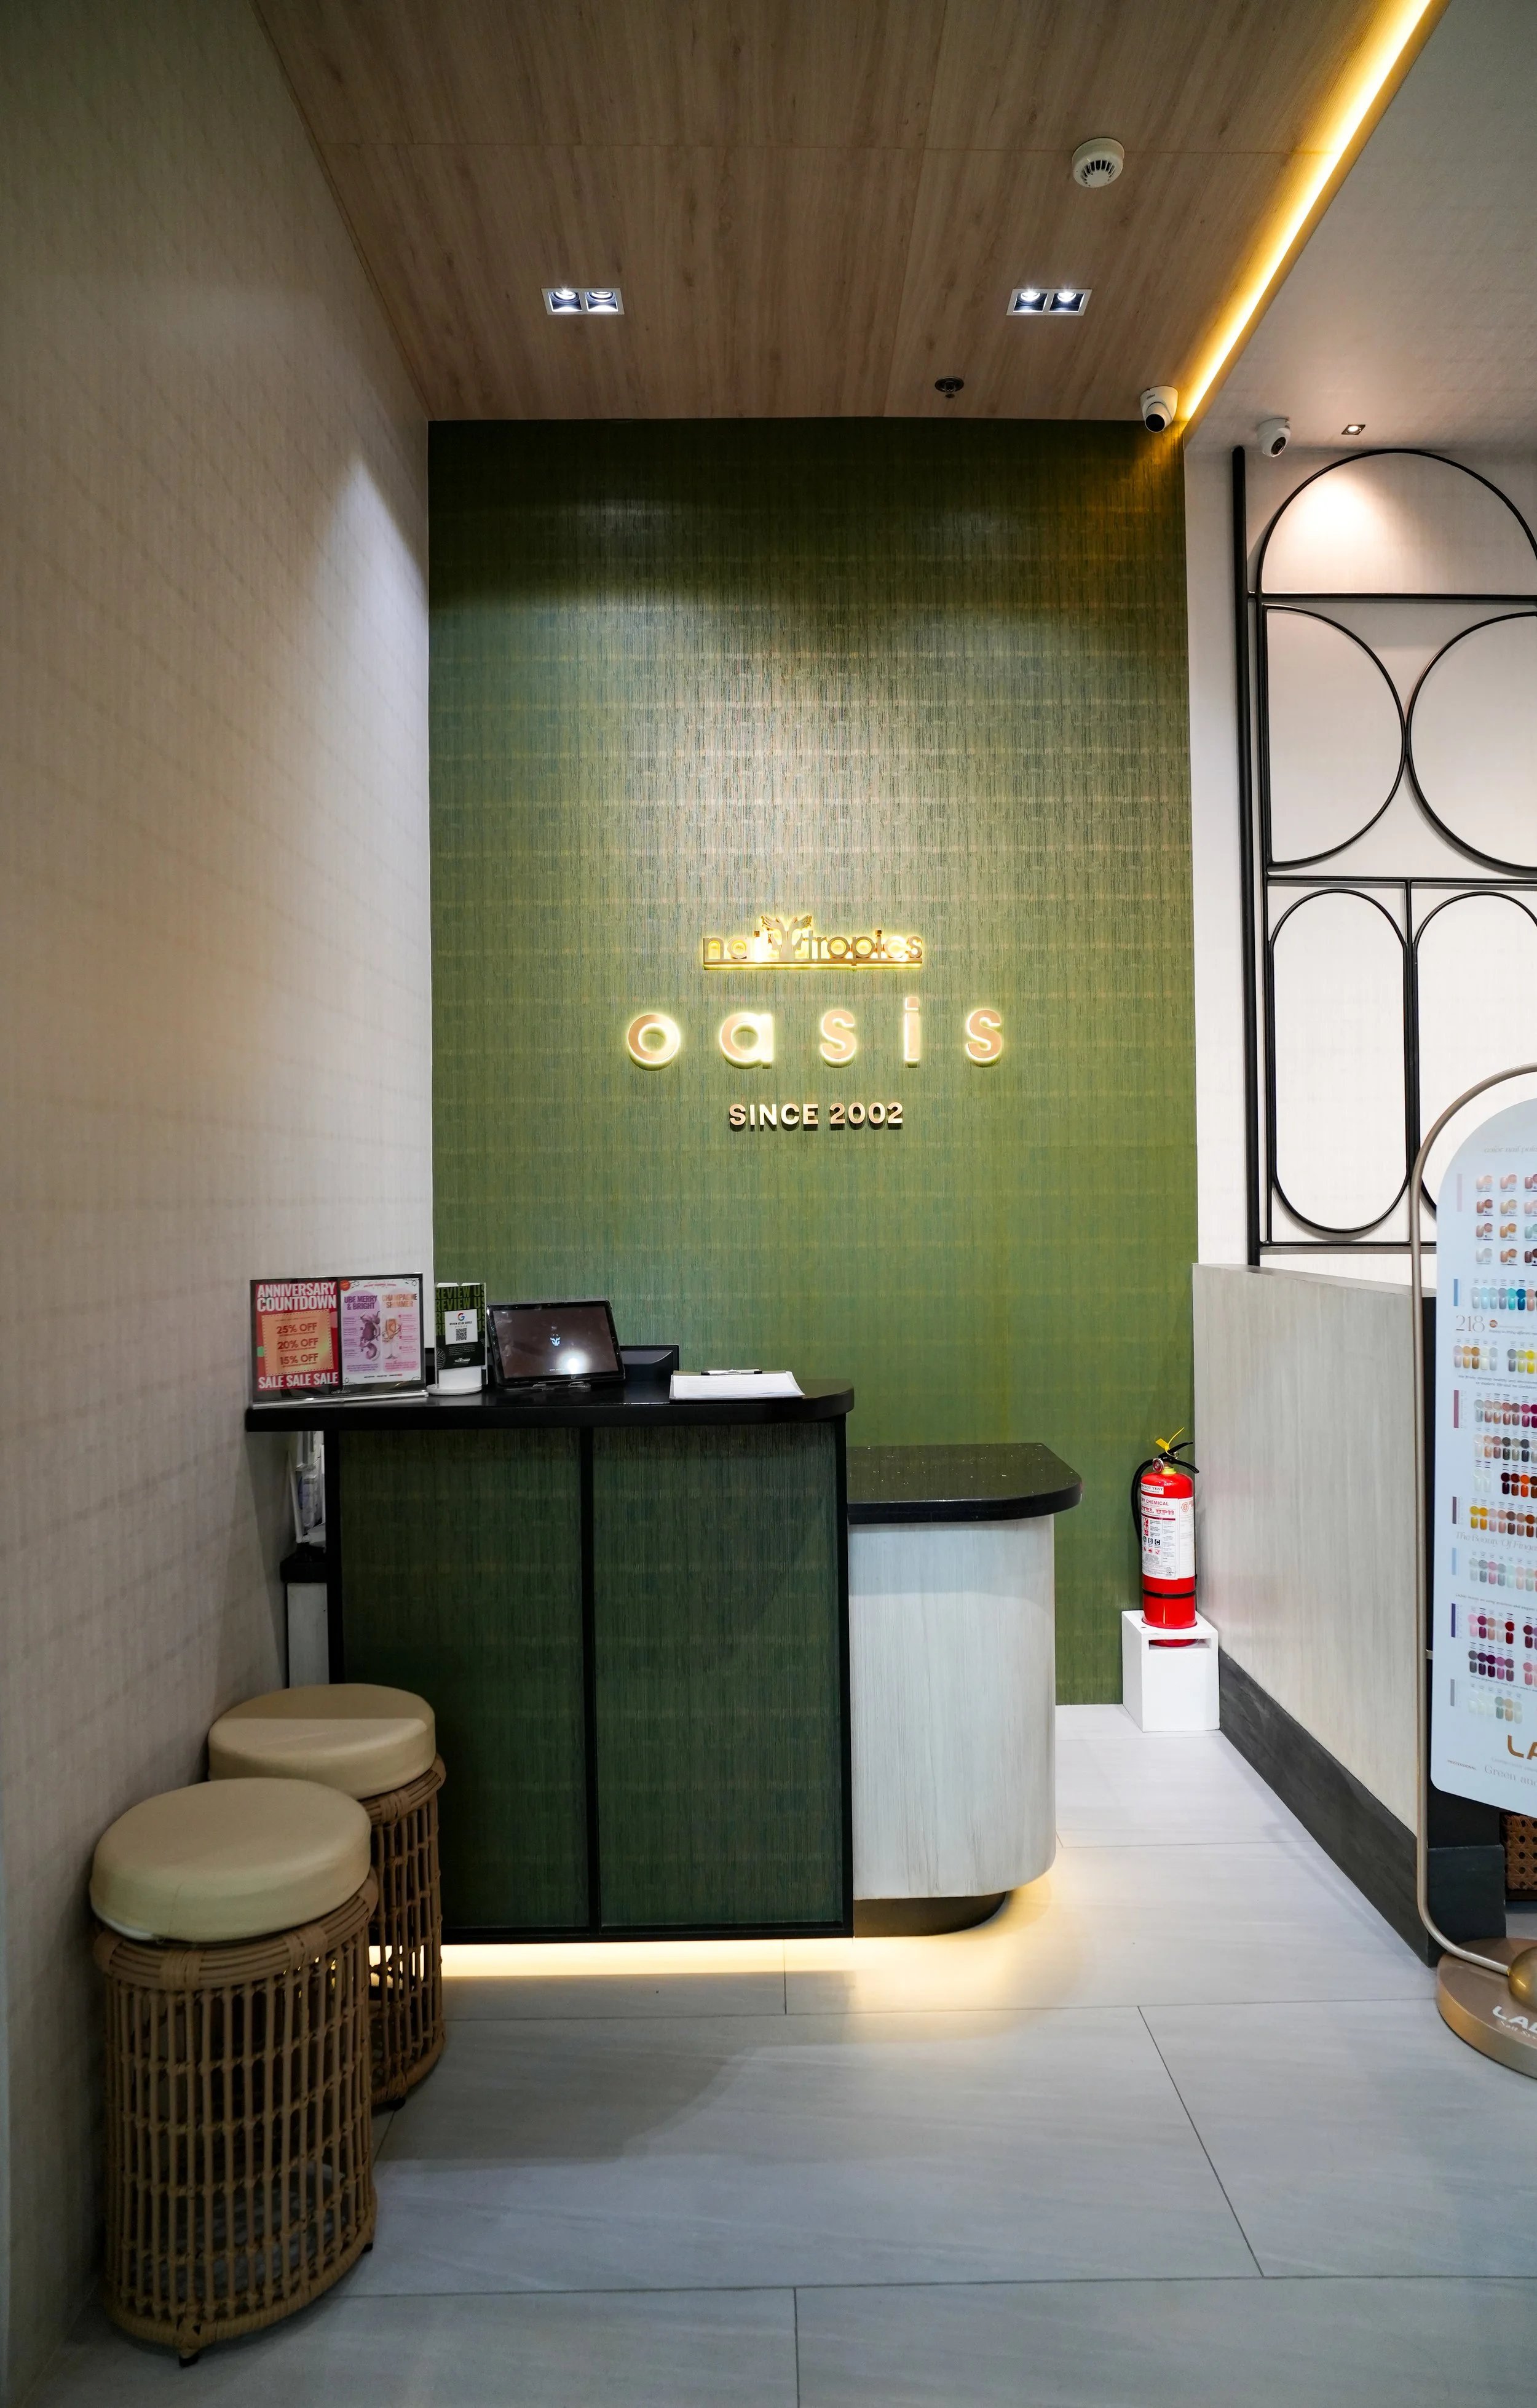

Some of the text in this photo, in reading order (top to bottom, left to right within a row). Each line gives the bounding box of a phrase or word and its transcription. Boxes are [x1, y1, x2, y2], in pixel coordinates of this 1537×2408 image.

[803, 930, 923, 966] tropics
[628, 996, 1003, 1066] oasis
[730, 1101, 903, 1126] SINCE 2002
[258, 1282, 336, 1297] ANNIVERSARY
[435, 1286, 470, 1299] REVIEW
[257, 1294, 337, 1312] COUNTDOWN
[435, 1297, 470, 1311] REVIEW
[276, 1325, 297, 1334] 25%
[299, 1323, 317, 1332] OFF
[1455, 1315, 1485, 1333] 218
[277, 1340, 299, 1350] 20%
[301, 1338, 319, 1347] OFF
[280, 1355, 298, 1365] 15%
[301, 1353, 318, 1363] OFF
[258, 1372, 339, 1389] SALE SALE SALE
[1484, 1764, 1516, 1782] Green
